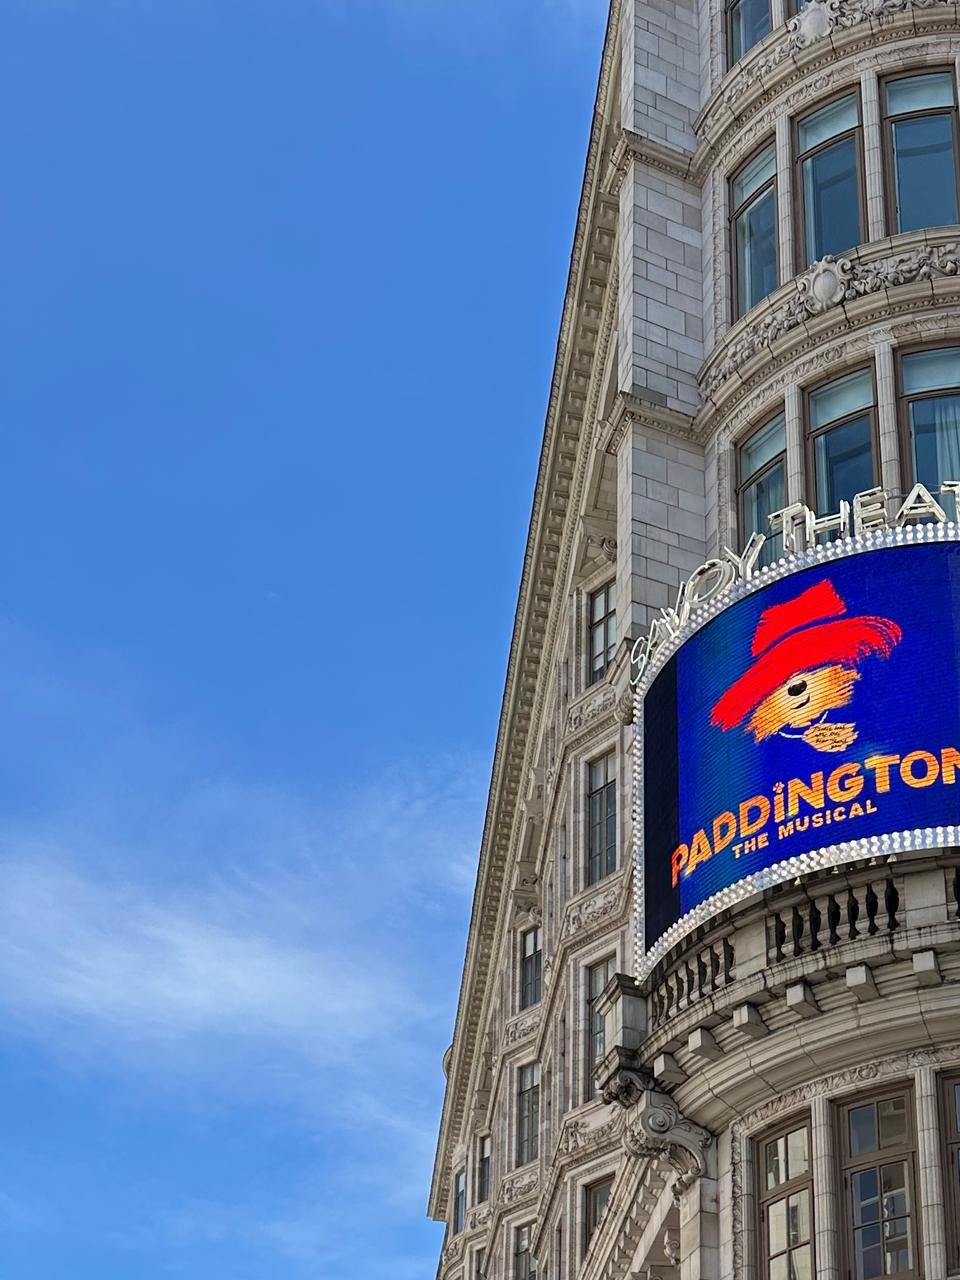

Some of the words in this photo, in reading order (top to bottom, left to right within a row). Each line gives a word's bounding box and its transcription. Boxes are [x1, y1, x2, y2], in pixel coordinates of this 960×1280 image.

[630, 531, 766, 686] SAVOY
[732, 832, 770, 859] THE
[778, 800, 878, 840] MUSICAL
